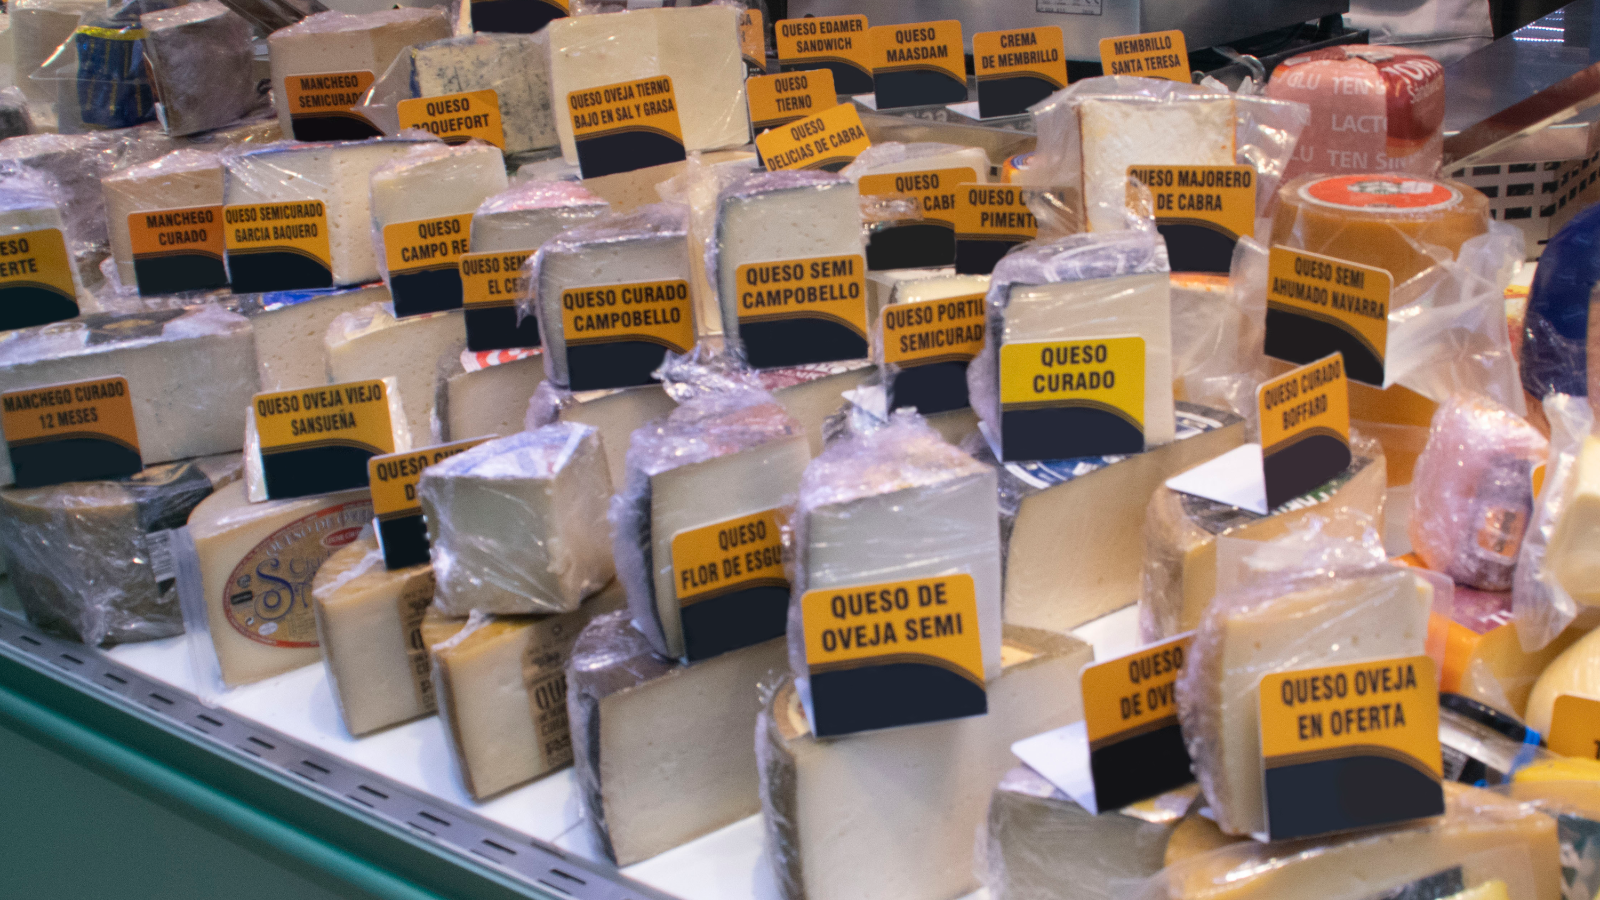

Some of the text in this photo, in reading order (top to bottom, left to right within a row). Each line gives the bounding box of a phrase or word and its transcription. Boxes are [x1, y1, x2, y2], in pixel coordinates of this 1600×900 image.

[781, 19, 863, 37] QUESO EDAMER
[895, 28, 936, 44] QUESO
[796, 37, 852, 53] SANDWICH
[1000, 32, 1037, 48] CREMA
[1114, 35, 1172, 56] MEMBRILLO
[886, 45, 948, 62] MAASDAM
[981, 48, 1059, 70] DE MEMBRILLO
[1111, 54, 1181, 75] SANTA TERESA
[300, 75, 358, 91] MANCHEGO
[569, 78, 670, 110] QUESO OVEJA TIERNO
[774, 75, 808, 93] QUESO
[298, 91, 363, 108] SEMICURAD
[426, 98, 470, 117] QUESO
[775, 95, 812, 113] TIERNO
[573, 98, 674, 130] BAJO EN SAL Y GRASA
[1332, 114, 1387, 133] LACT
[791, 118, 826, 141] QUESO
[767, 124, 865, 172] DELICIAS DE CABRA
[895, 173, 940, 193] QUESO
[1130, 169, 1252, 188] QUESO MAJORERO
[968, 189, 1014, 206] QUESO
[1156, 194, 1223, 212] DE CABRA
[146, 209, 214, 229] MANCHEGO
[225, 202, 323, 224] QUESO SEMICURADO
[158, 229, 208, 246] CURADO
[234, 223, 318, 243] GARCIA BAQUERO
[418, 219, 461, 239] QUESO
[0, 238, 29, 256] ESO
[401, 238, 468, 262] CAMPO RE
[0, 258, 38, 277] ERTE
[462, 254, 529, 276] QUESO SEM
[746, 259, 853, 286] QUESO SEMI
[1294, 256, 1365, 290] QUESO SEMI
[488, 279, 502, 294] EL
[562, 283, 687, 311] QUESO CURADO
[742, 282, 860, 310] CAMPOBELLO
[1271, 276, 1385, 321] AHUMADO NAVARRA
[574, 307, 681, 332] CAMPOBELLO
[885, 298, 985, 331] QUESO PORTIL
[1041, 344, 1108, 368] QUESO
[1032, 371, 1116, 394] CURADO
[1264, 360, 1342, 411] QUESO CURADO
[4, 381, 125, 412] MANCHEGO CURADO
[257, 384, 382, 418] QUESO OVEJA VIEJO
[39, 407, 98, 430] 12 MESES
[291, 408, 357, 436] SANSUEÑA
[1282, 393, 1328, 431] BOFFARD
[376, 455, 428, 482] QUESO
[404, 484, 416, 501] D
[718, 520, 767, 551] QUESO
[681, 544, 786, 590] FLOR DE ESGU
[831, 583, 947, 620] QUESO DE
[821, 613, 963, 653] OVEJA SEMI
[1129, 646, 1183, 685] QUESO
[1281, 664, 1418, 708] QUESO OVEJA
[1121, 681, 1177, 721] DE OVE
[1297, 703, 1407, 741] EN OFERTA
